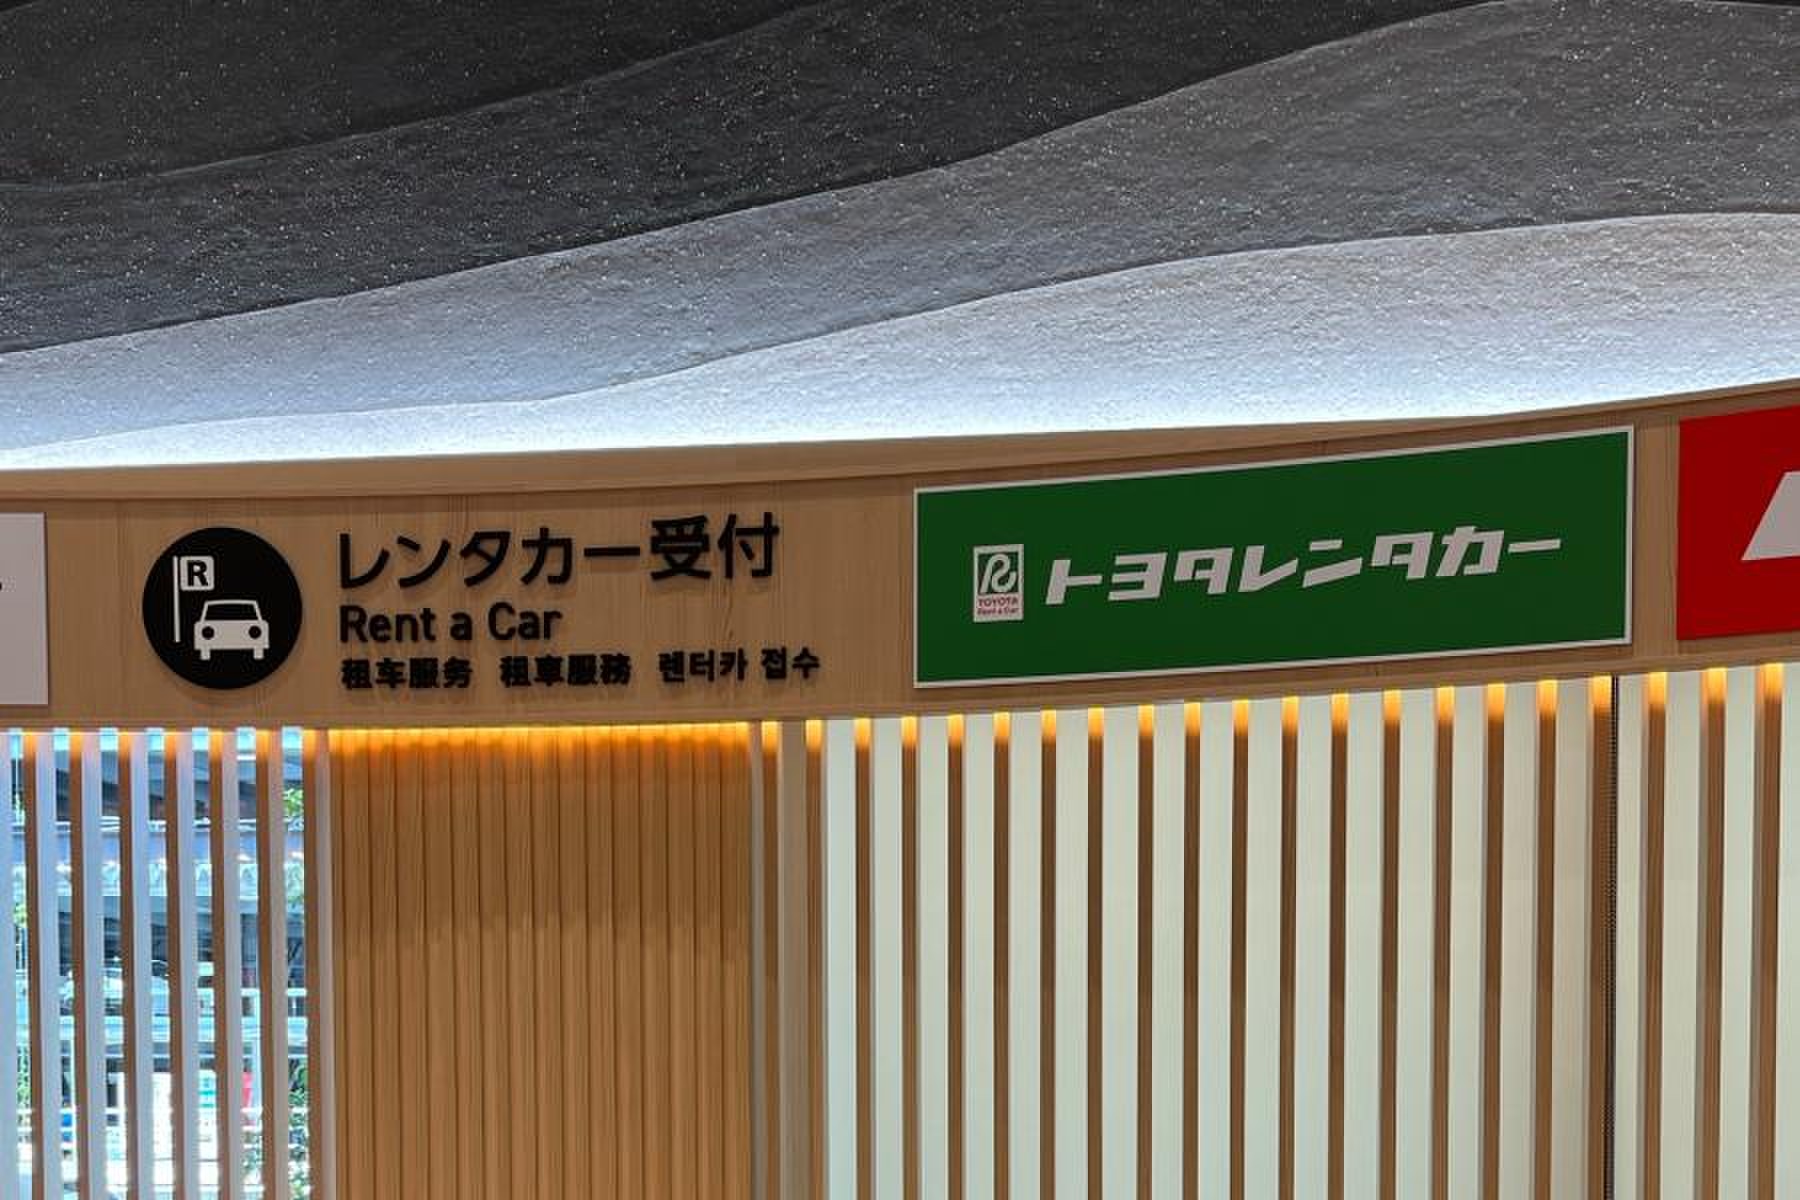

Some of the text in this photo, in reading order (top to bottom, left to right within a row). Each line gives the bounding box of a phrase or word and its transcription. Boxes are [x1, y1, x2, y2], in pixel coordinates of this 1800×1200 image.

[339, 511, 781, 591] レンタカー受付
[1044, 524, 1562, 605] トヨタレンタカー
[339, 601, 564, 645] Rent a Car
[977, 597, 1019, 607] TOYOTA
[340, 652, 633, 692] 租车服务 租車服務
[657, 645, 822, 685] 렌터카 접수
